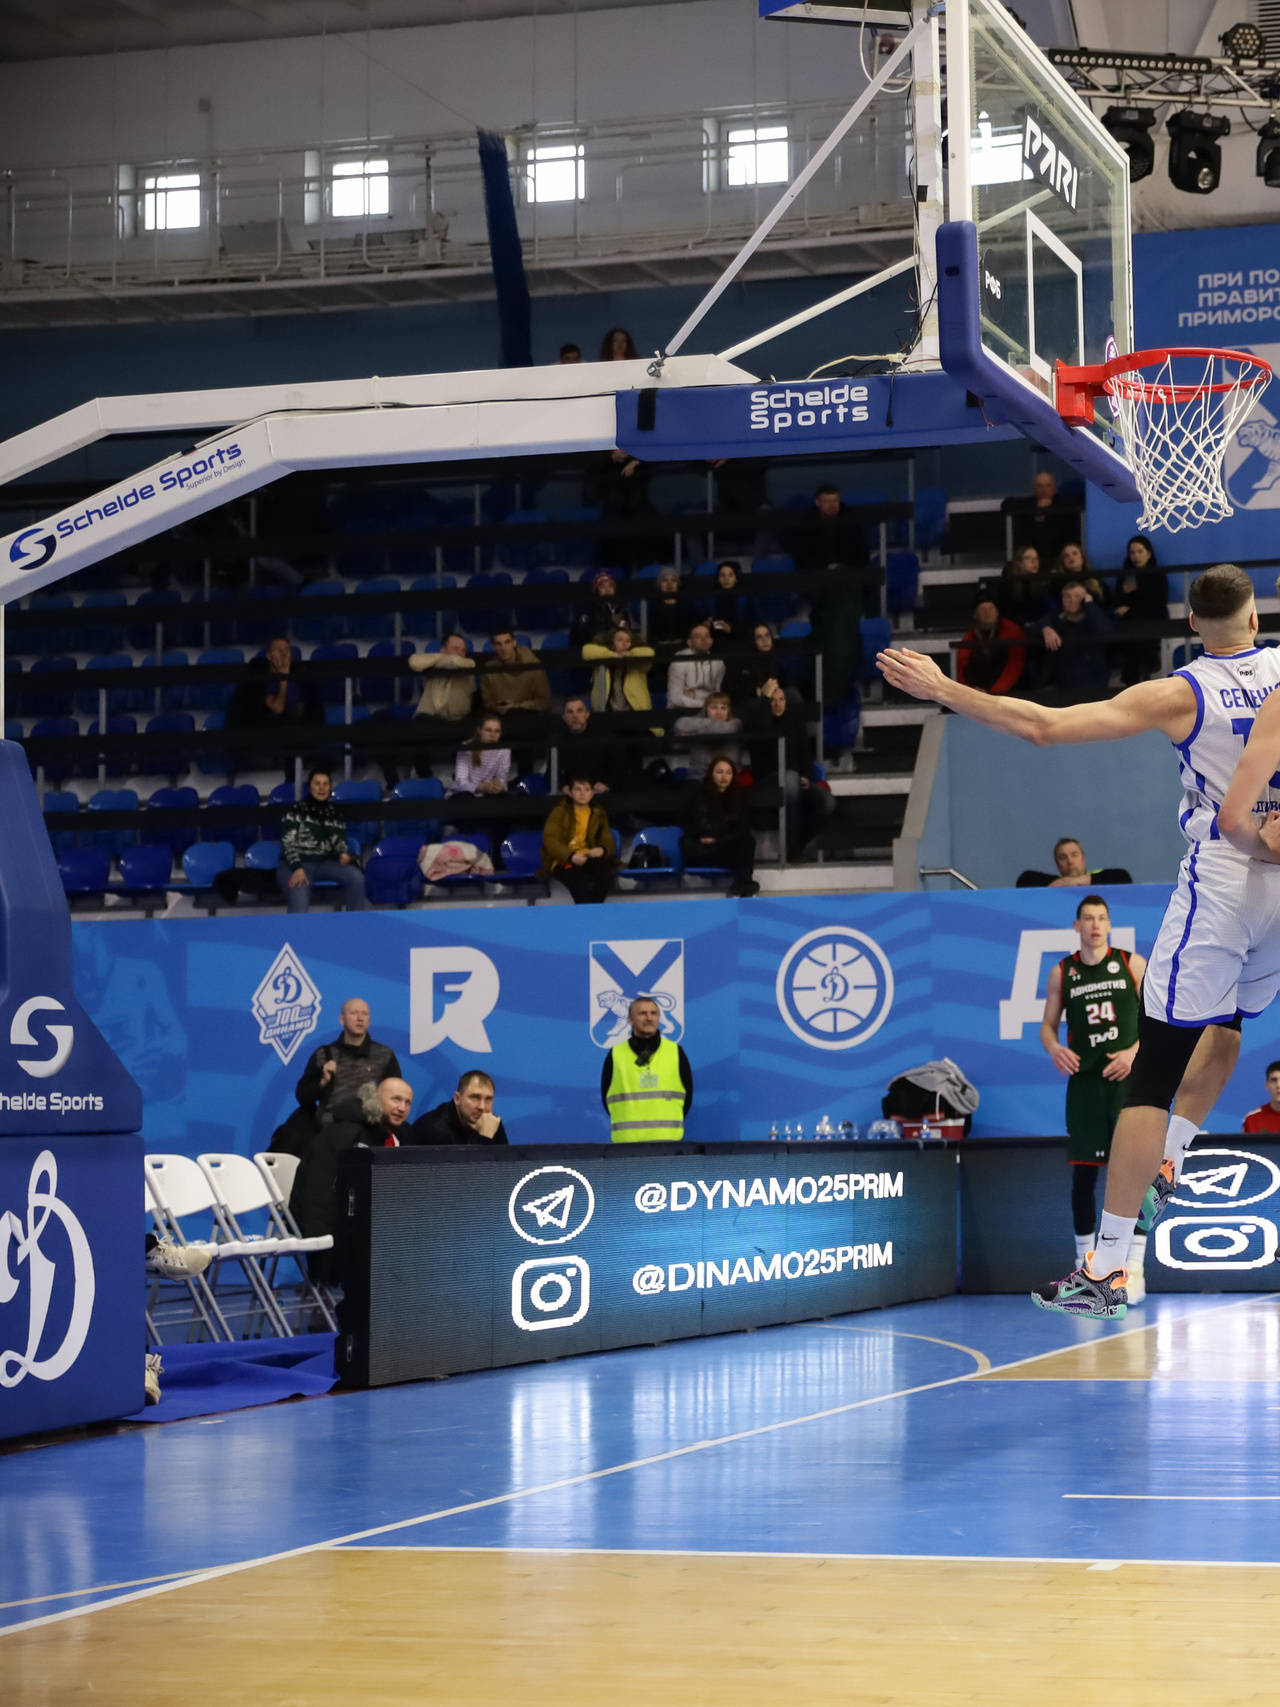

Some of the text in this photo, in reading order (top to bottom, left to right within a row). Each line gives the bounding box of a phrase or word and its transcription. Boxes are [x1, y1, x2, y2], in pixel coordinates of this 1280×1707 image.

[1025, 115, 1078, 210] PARI
[985, 271, 1002, 300] РФБ
[1198, 272, 1243, 289] ПРИ
[750, 384, 869, 410] Schelde
[750, 404, 870, 434] Sports
[186, 459, 246, 490] Superior by Design
[56, 484, 156, 539] Schelde
[159, 443, 242, 491] Sports
[1219, 682, 1280, 709] СЕЛЕН
[1070, 978, 1127, 998] ЛОКОМОТИВ
[1085, 1001, 1117, 1025] 24
[0, 1092, 104, 1115] helde Sports
[634, 1172, 904, 1213] @DYNAMO25PRIM
[632, 1241, 893, 1295] @DINAMO25PRIM
